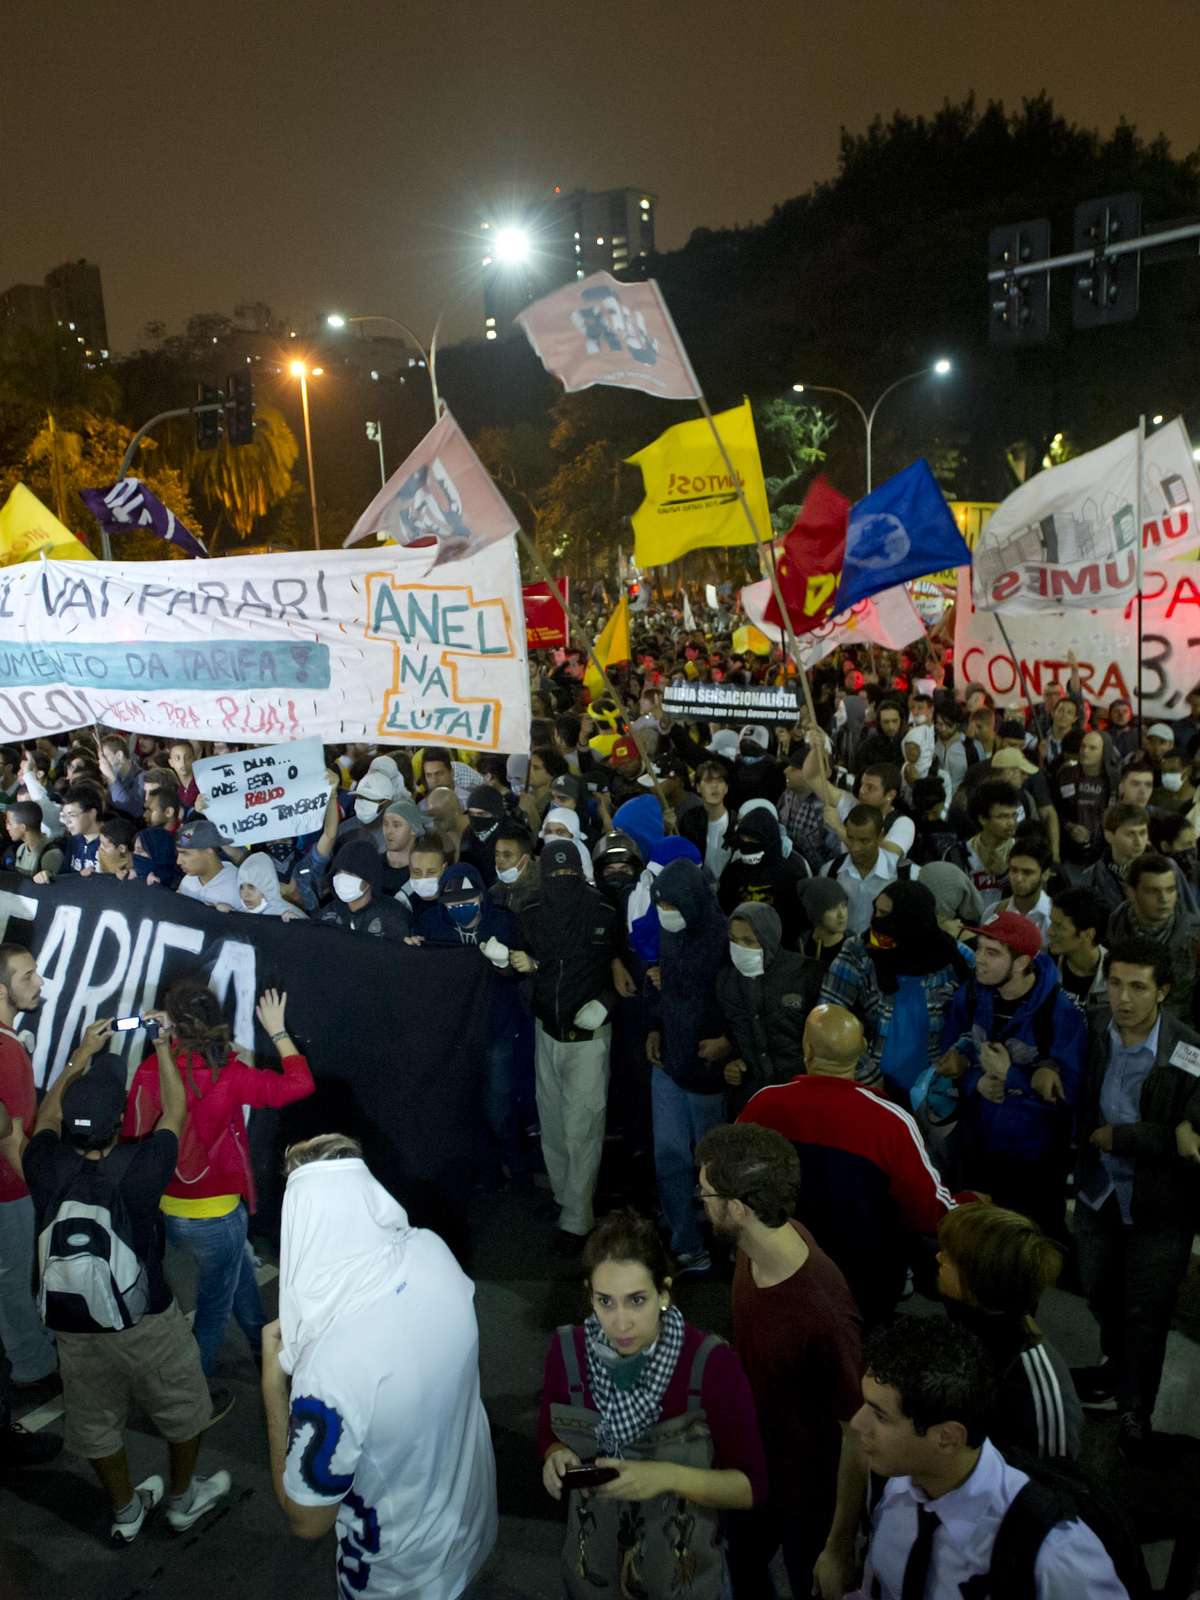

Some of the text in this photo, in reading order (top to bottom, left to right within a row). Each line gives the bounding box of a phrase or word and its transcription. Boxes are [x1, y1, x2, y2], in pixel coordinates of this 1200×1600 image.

[42, 573, 109, 619] VAI
[138, 570, 330, 620] PARAR!
[372, 582, 509, 654] ANEL
[126, 653, 169, 679] DA
[175, 649, 277, 681] TARIFA
[401, 654, 449, 698] NA
[961, 647, 1131, 708] CONTRA
[387, 700, 491, 741] LUTA!
[211, 781, 238, 798] ONDE
[288, 765, 298, 779] O
[232, 812, 268, 834] NOSSO
